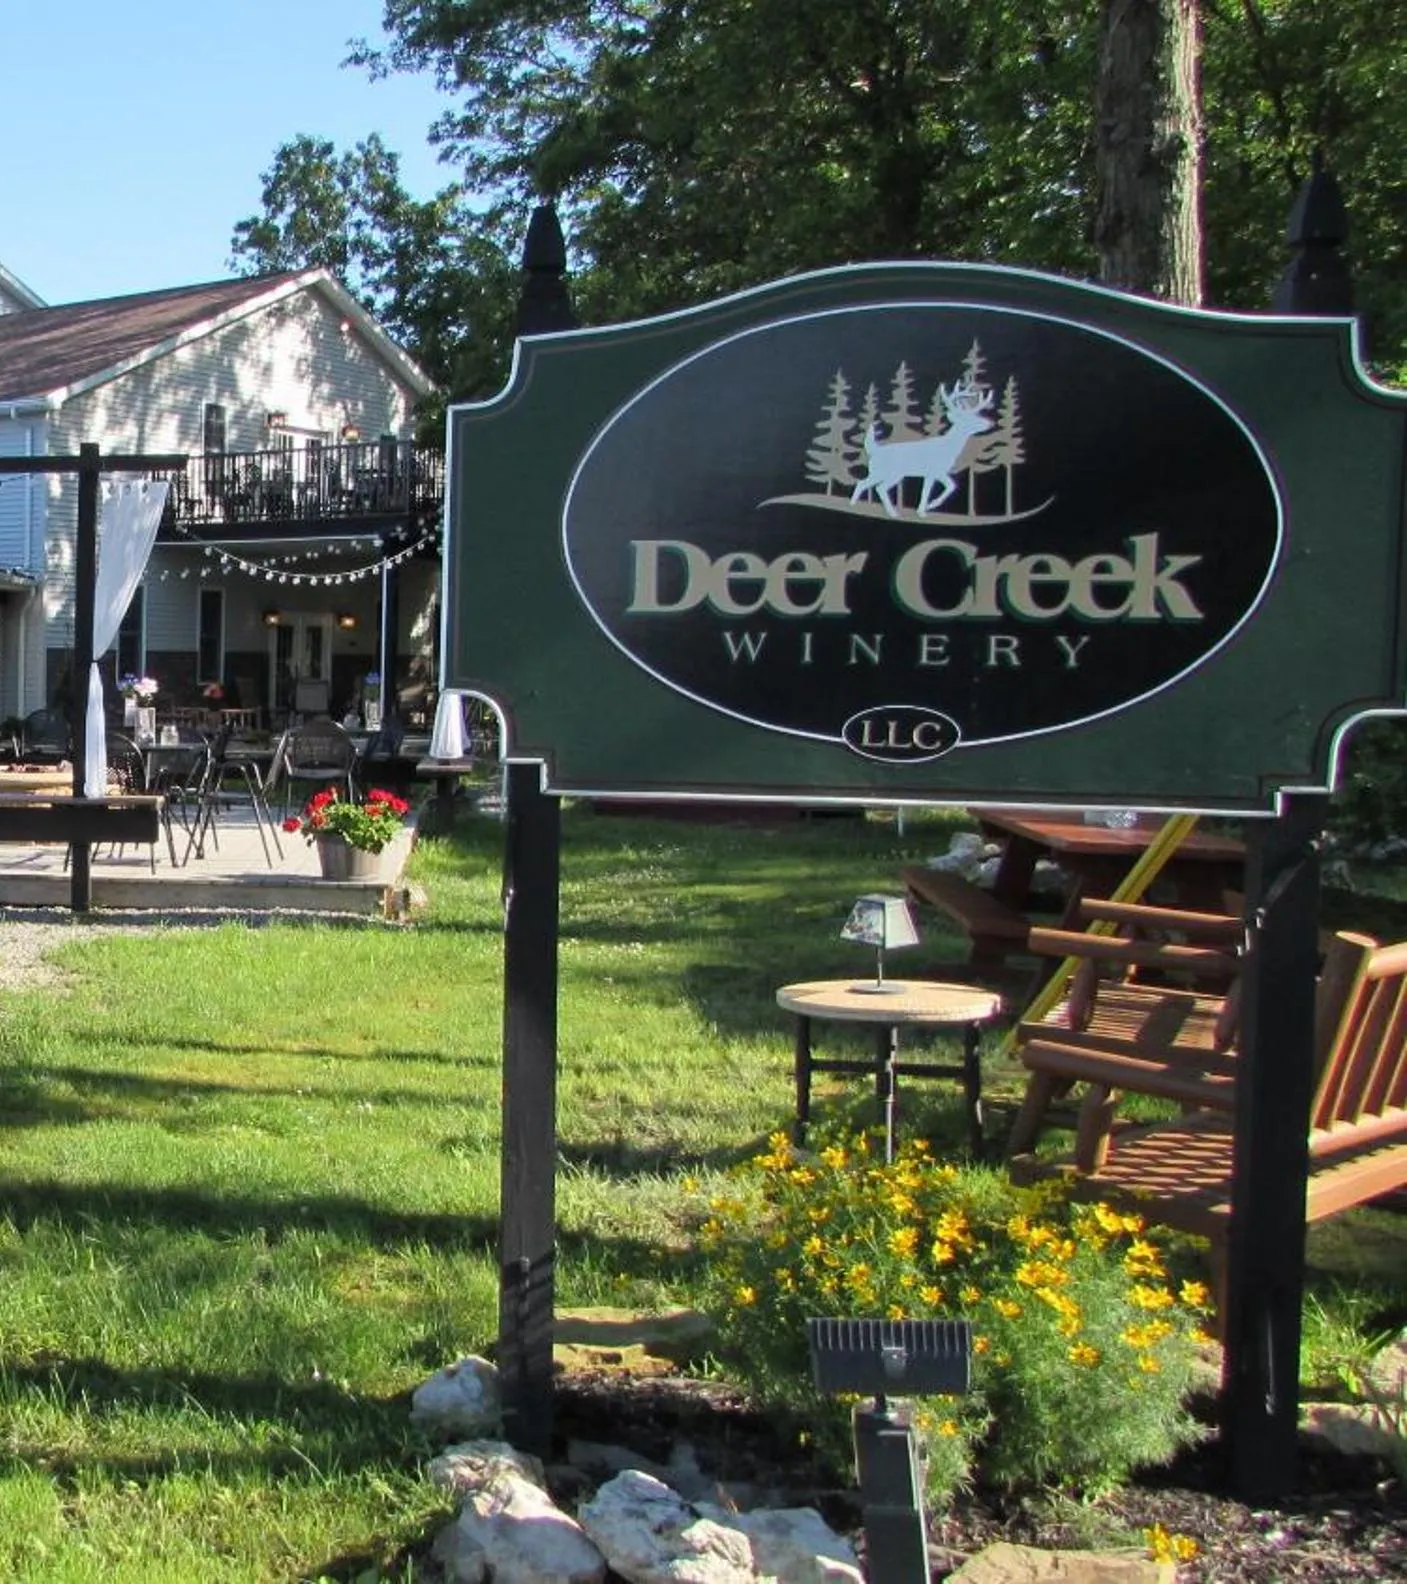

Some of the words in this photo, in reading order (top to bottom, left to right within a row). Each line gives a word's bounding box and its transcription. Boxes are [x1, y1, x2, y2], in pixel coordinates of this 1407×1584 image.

[627, 539, 869, 615] Deer
[894, 532, 1204, 620] Creek
[723, 631, 1092, 667] WINERY
[861, 720, 942, 750] LLC
